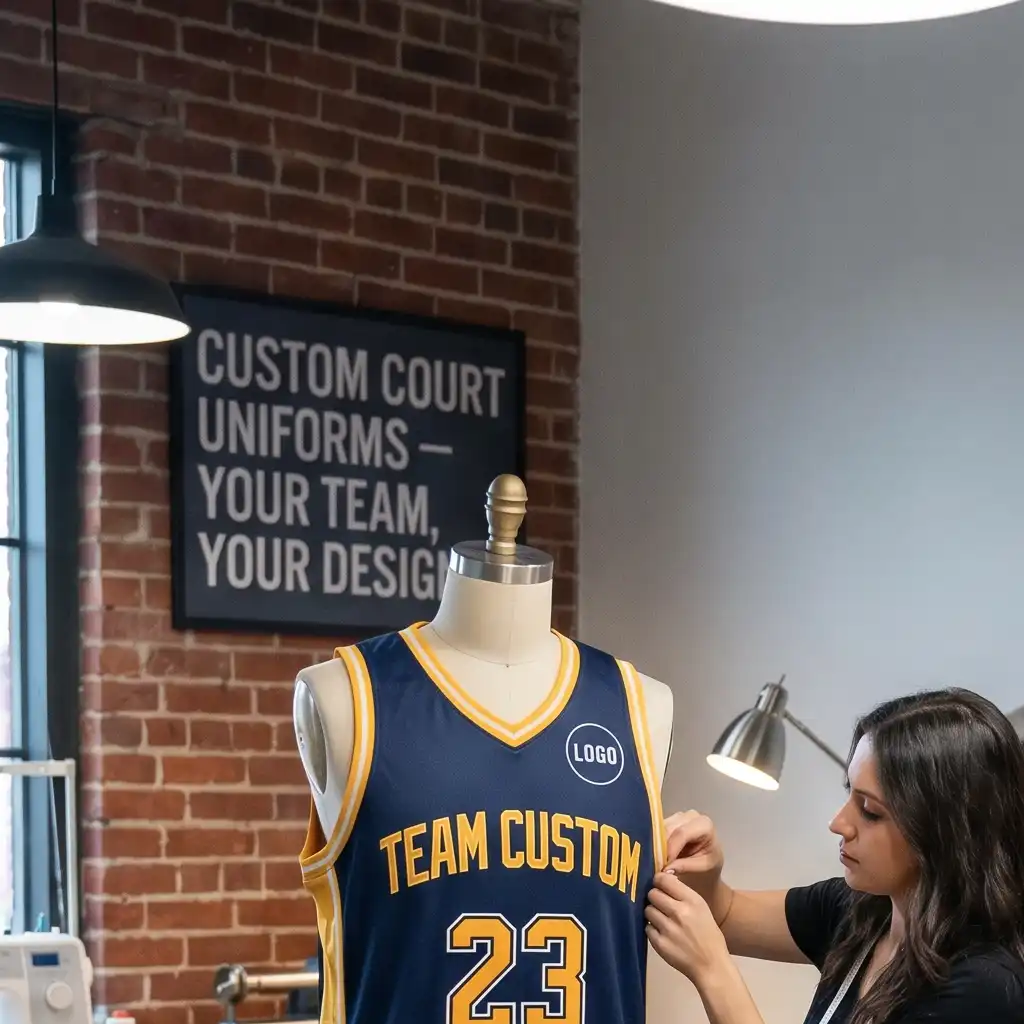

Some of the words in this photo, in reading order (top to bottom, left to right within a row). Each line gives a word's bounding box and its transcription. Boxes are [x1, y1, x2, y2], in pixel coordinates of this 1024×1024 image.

[197, 328, 369, 401] CUSTOM
[381, 353, 505, 418] COURT
[198, 397, 409, 470] UNIFORMS
[198, 464, 310, 528] YOUR
[321, 476, 440, 546] TEAM,
[198, 532, 310, 593] YOUR
[573, 742, 617, 766] LOGO
[379, 810, 489, 895] TEAM
[500, 809, 641, 903] CUSTOM
